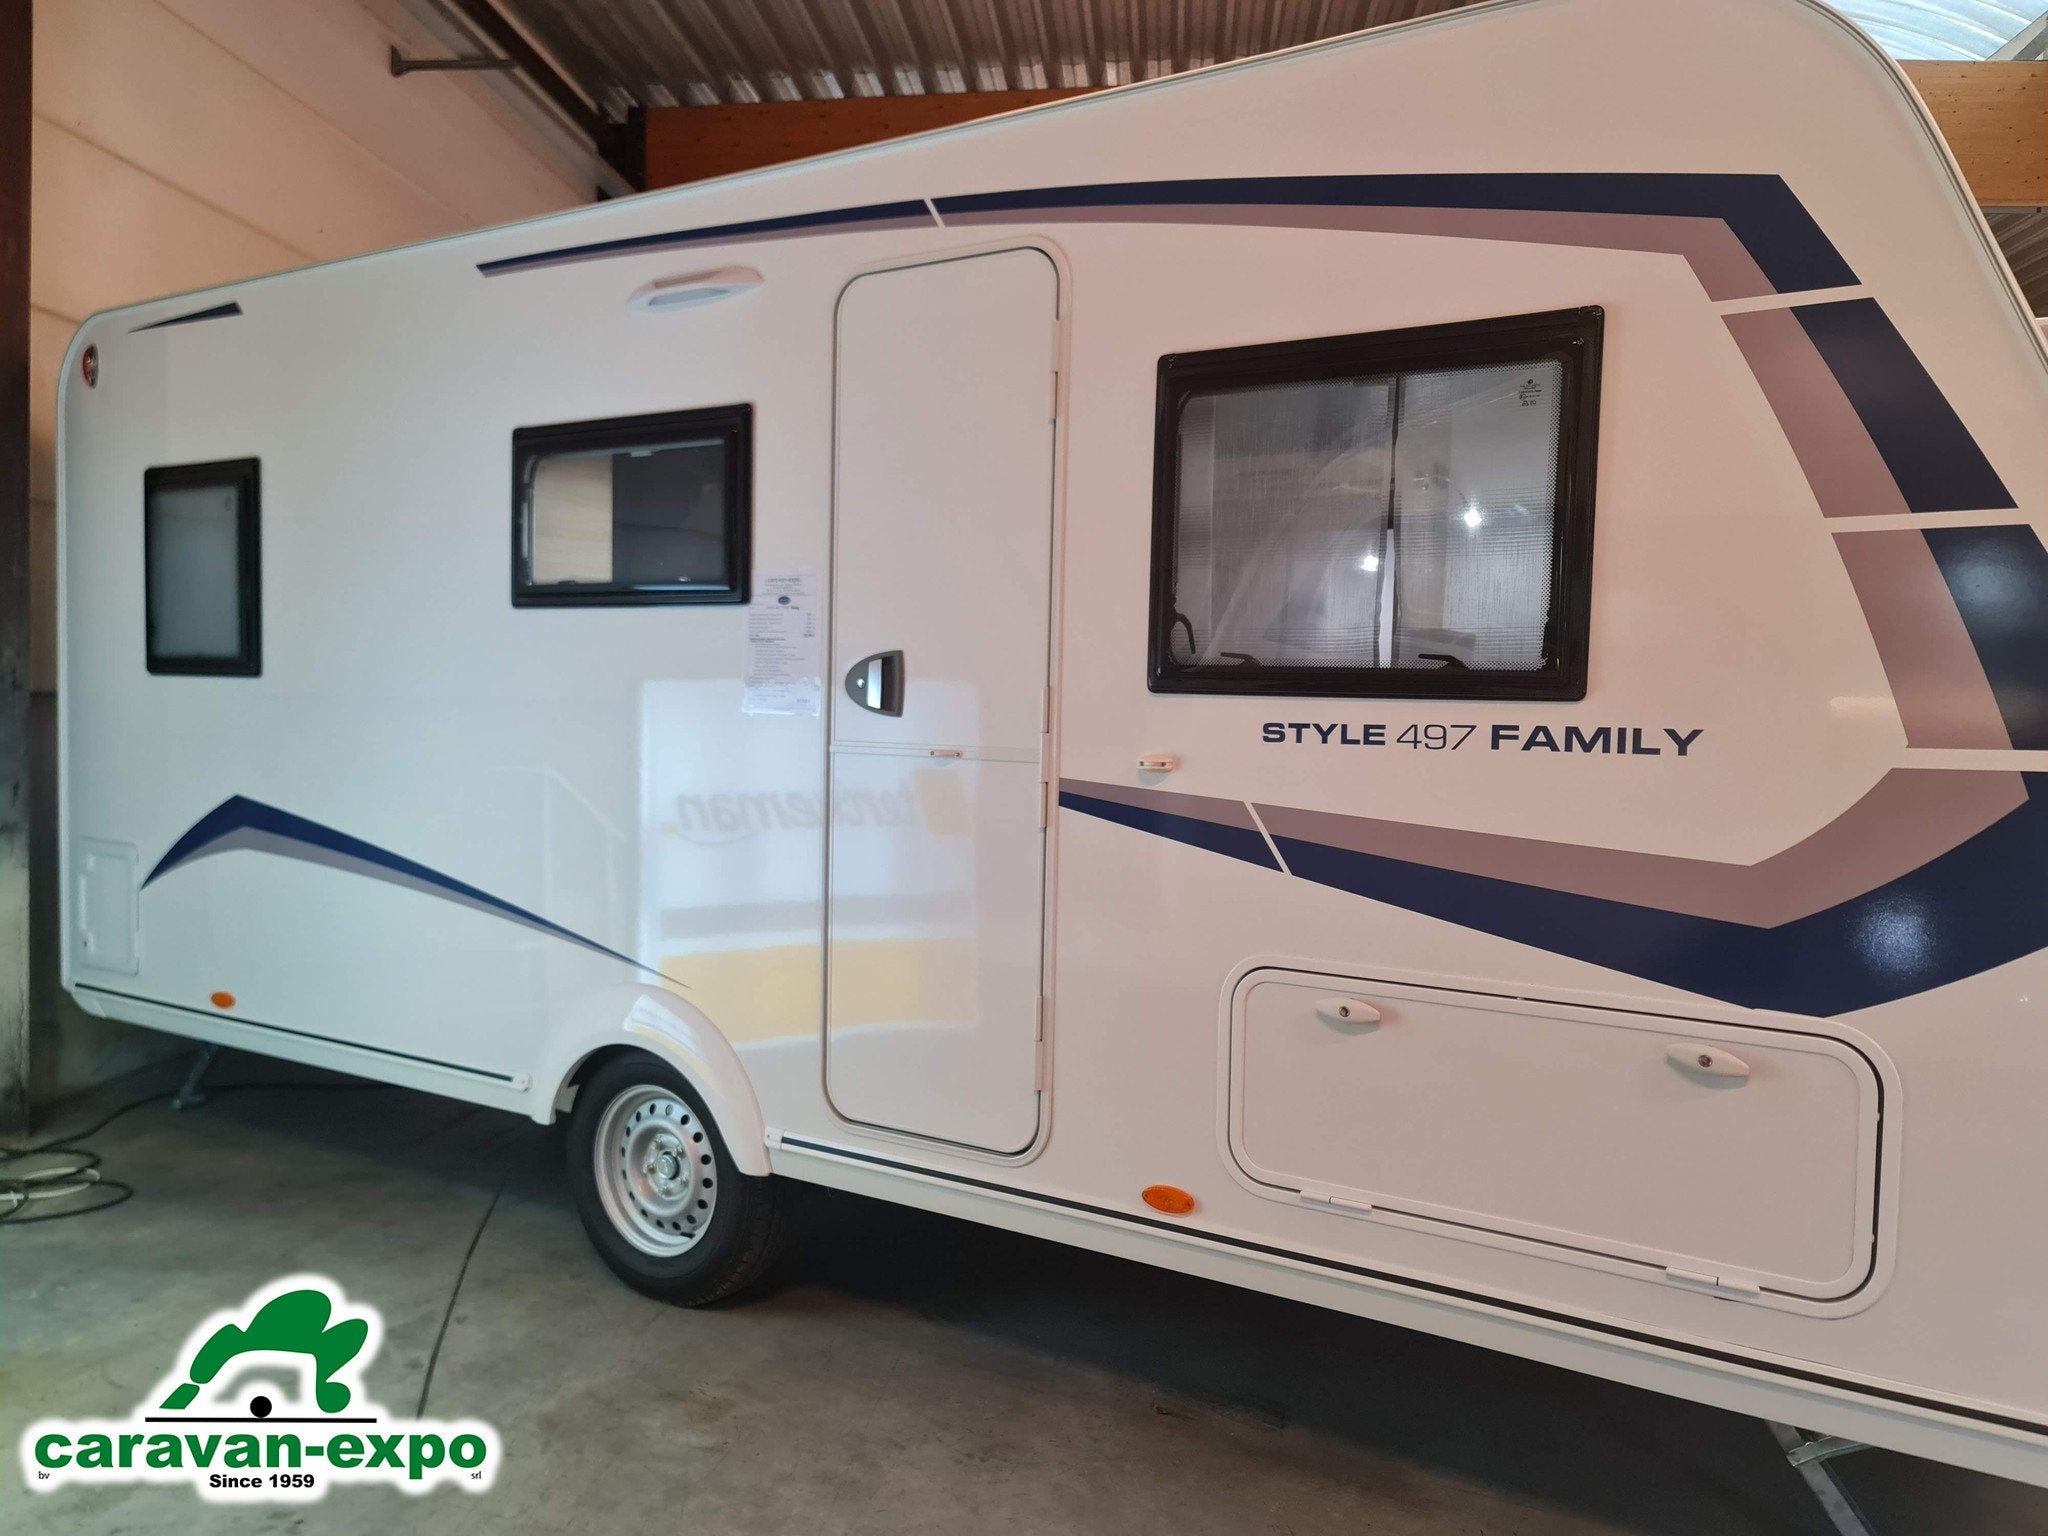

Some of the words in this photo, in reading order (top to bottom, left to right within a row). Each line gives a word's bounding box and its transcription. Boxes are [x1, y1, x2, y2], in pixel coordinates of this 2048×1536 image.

[1262, 722, 1386, 746] STYLE
[1396, 724, 1478, 750] 497
[1490, 724, 1705, 756] FAMILY
